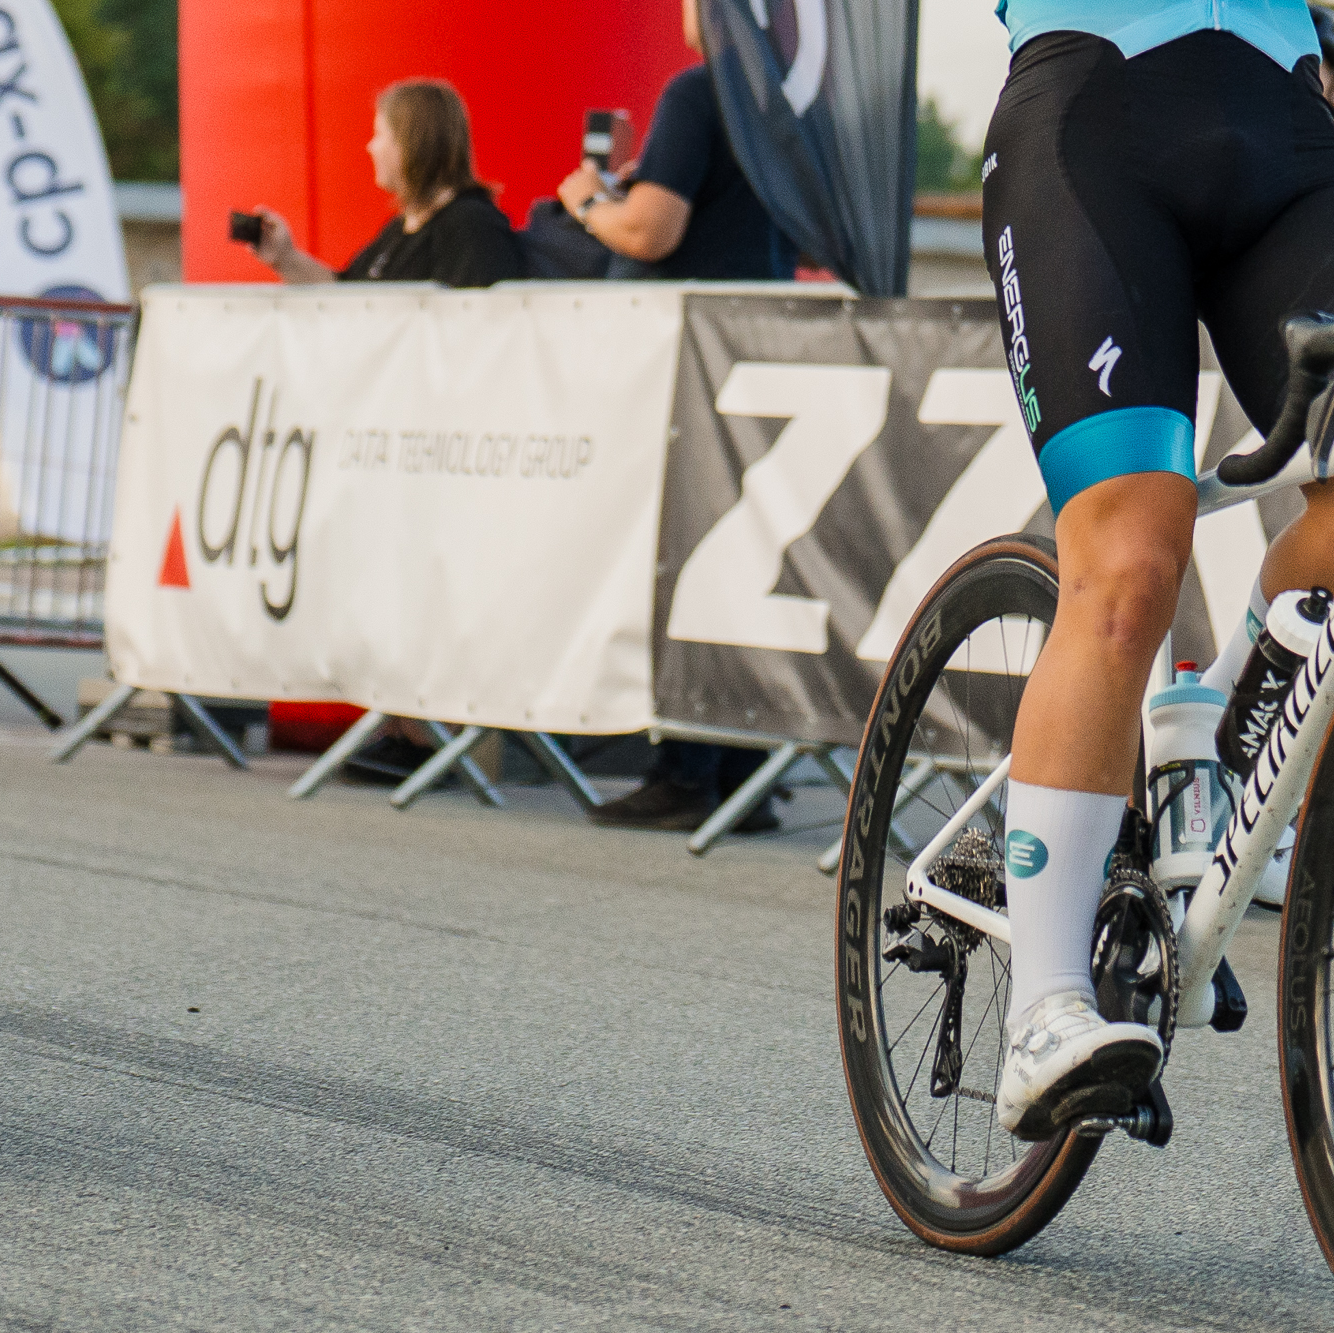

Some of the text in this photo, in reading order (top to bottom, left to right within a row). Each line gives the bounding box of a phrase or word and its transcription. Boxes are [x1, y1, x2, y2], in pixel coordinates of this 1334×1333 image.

[998, 225, 1041, 433] ENERGUS
[846, 609, 943, 1044] BONTRAGER
[1192, 777, 1201, 815] VILNIUS
[1290, 870, 1315, 1031] AEOLUS
